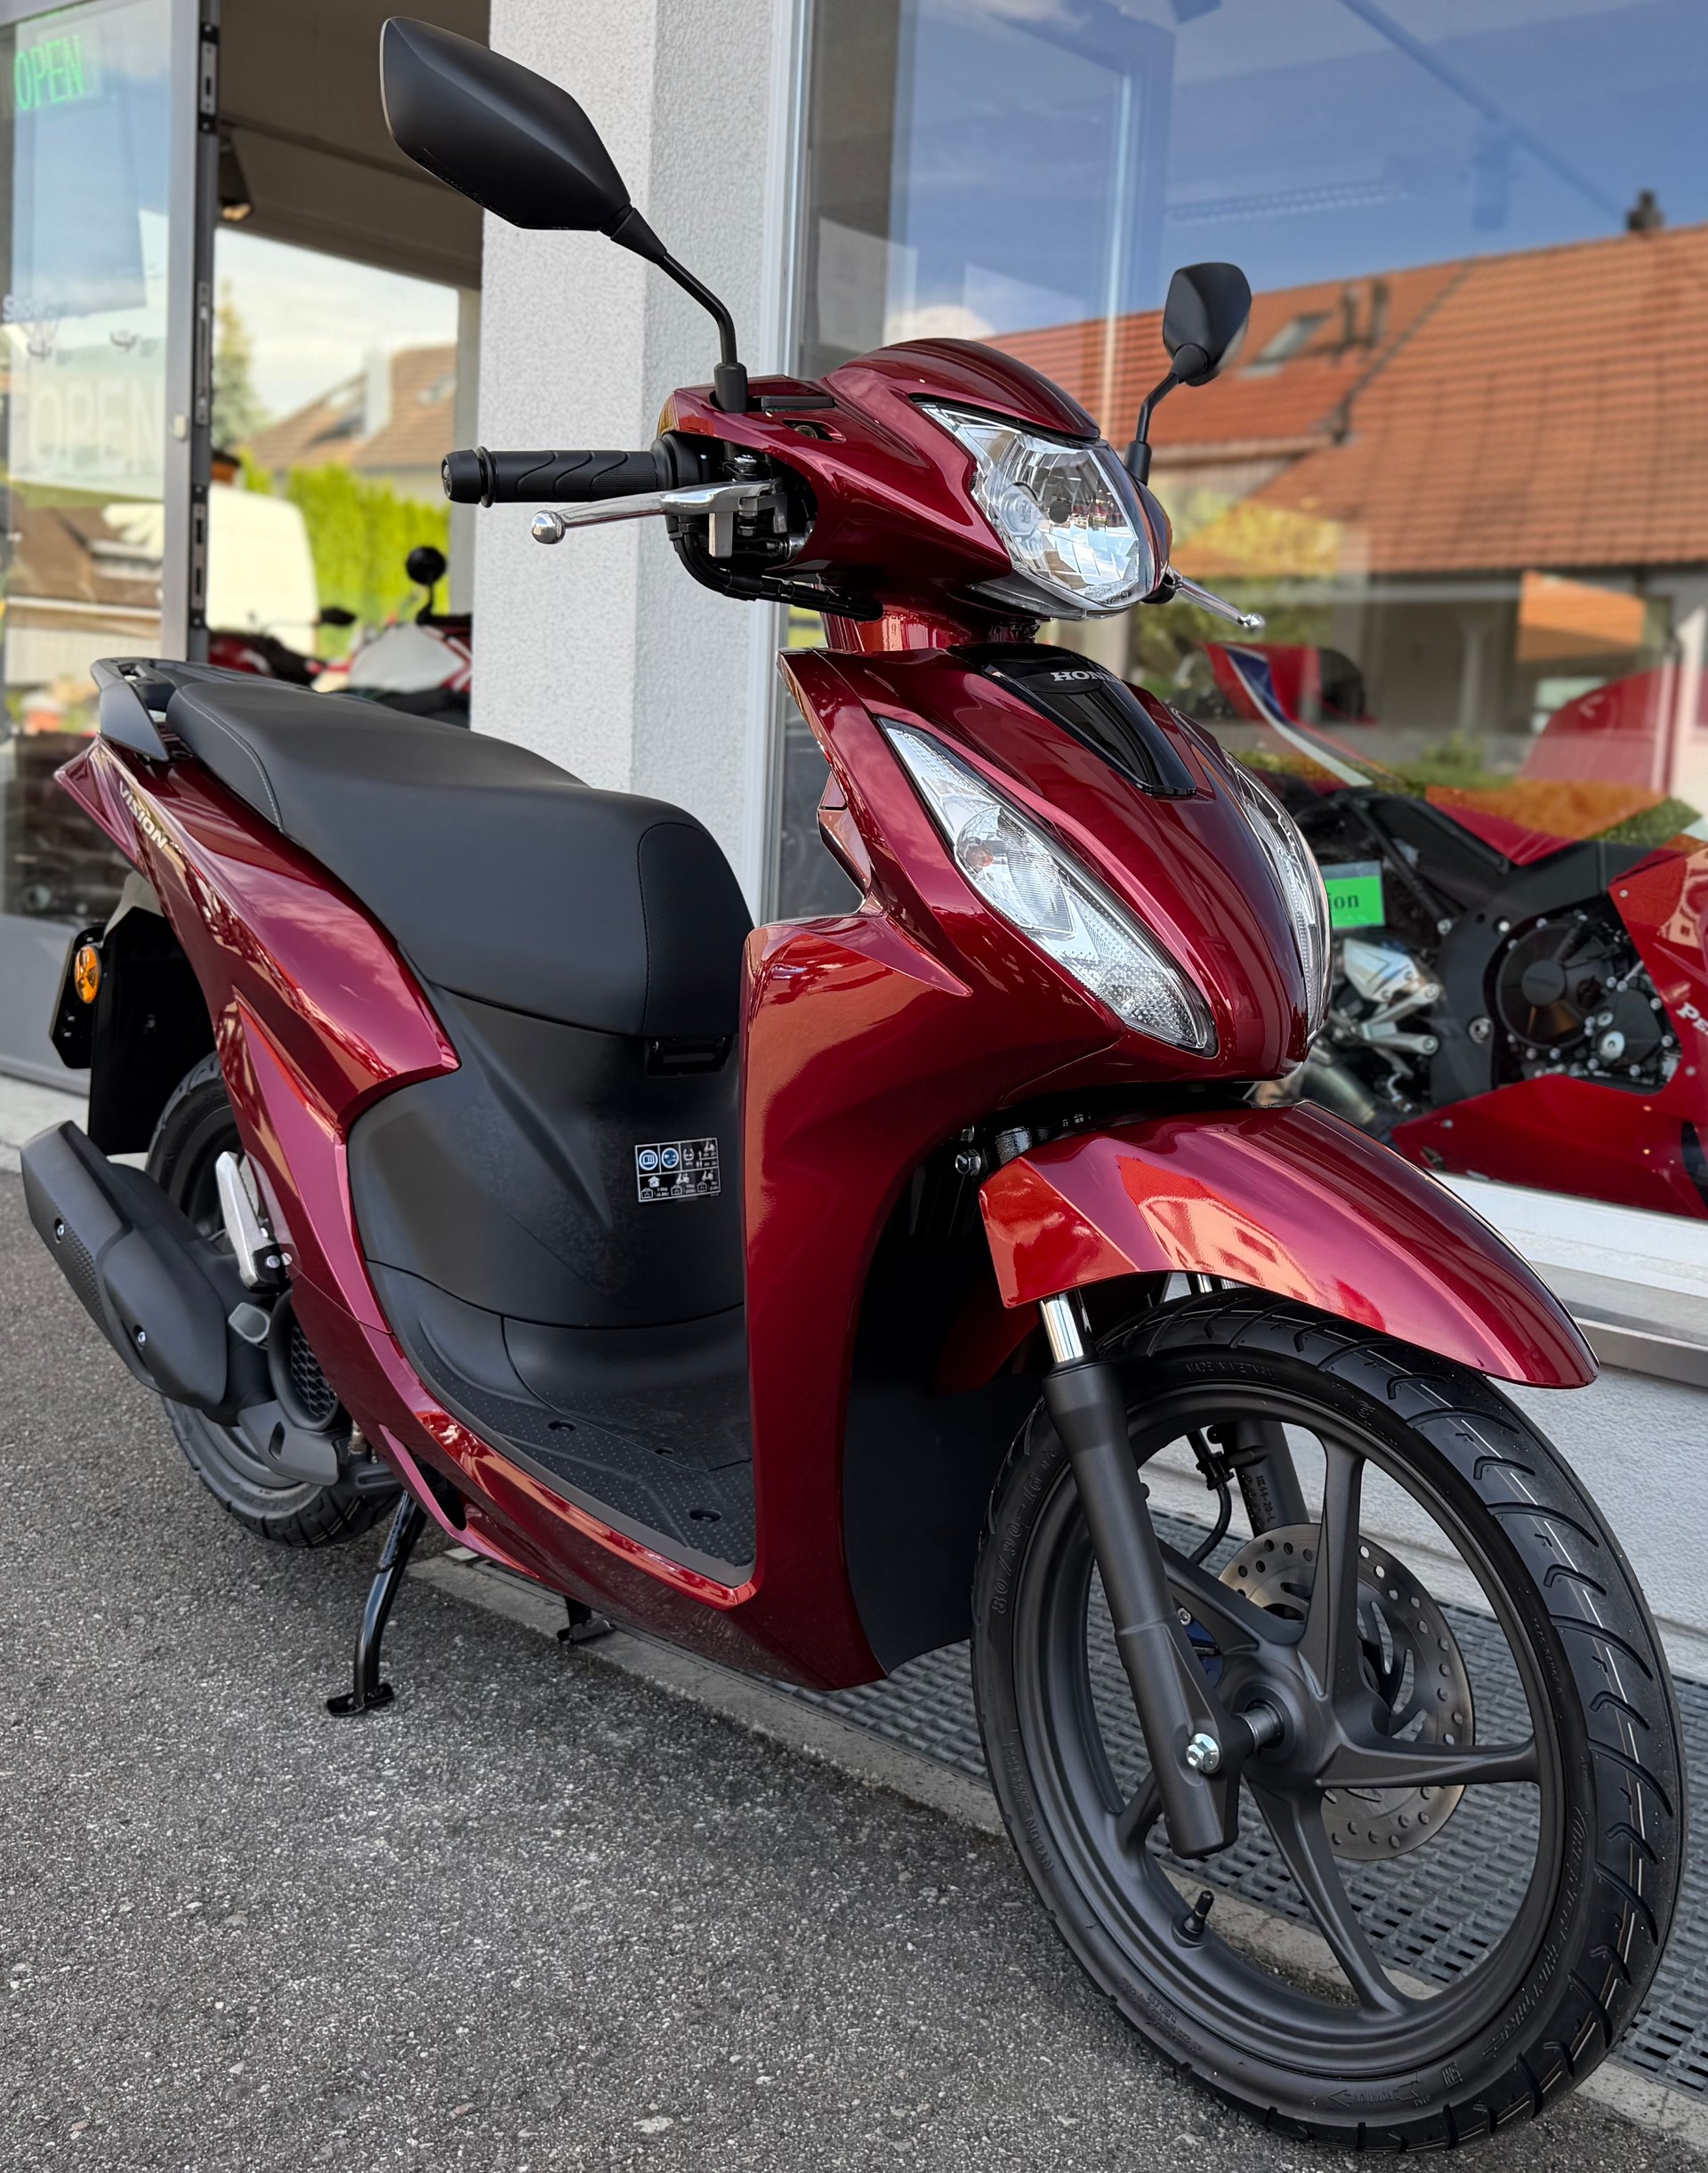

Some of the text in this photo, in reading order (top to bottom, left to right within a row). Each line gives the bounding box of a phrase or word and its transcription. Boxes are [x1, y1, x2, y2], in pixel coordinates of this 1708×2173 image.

[13, 34, 85, 111] OPEN
[29, 375, 164, 476] OPEN
[119, 780, 168, 849] VISION
